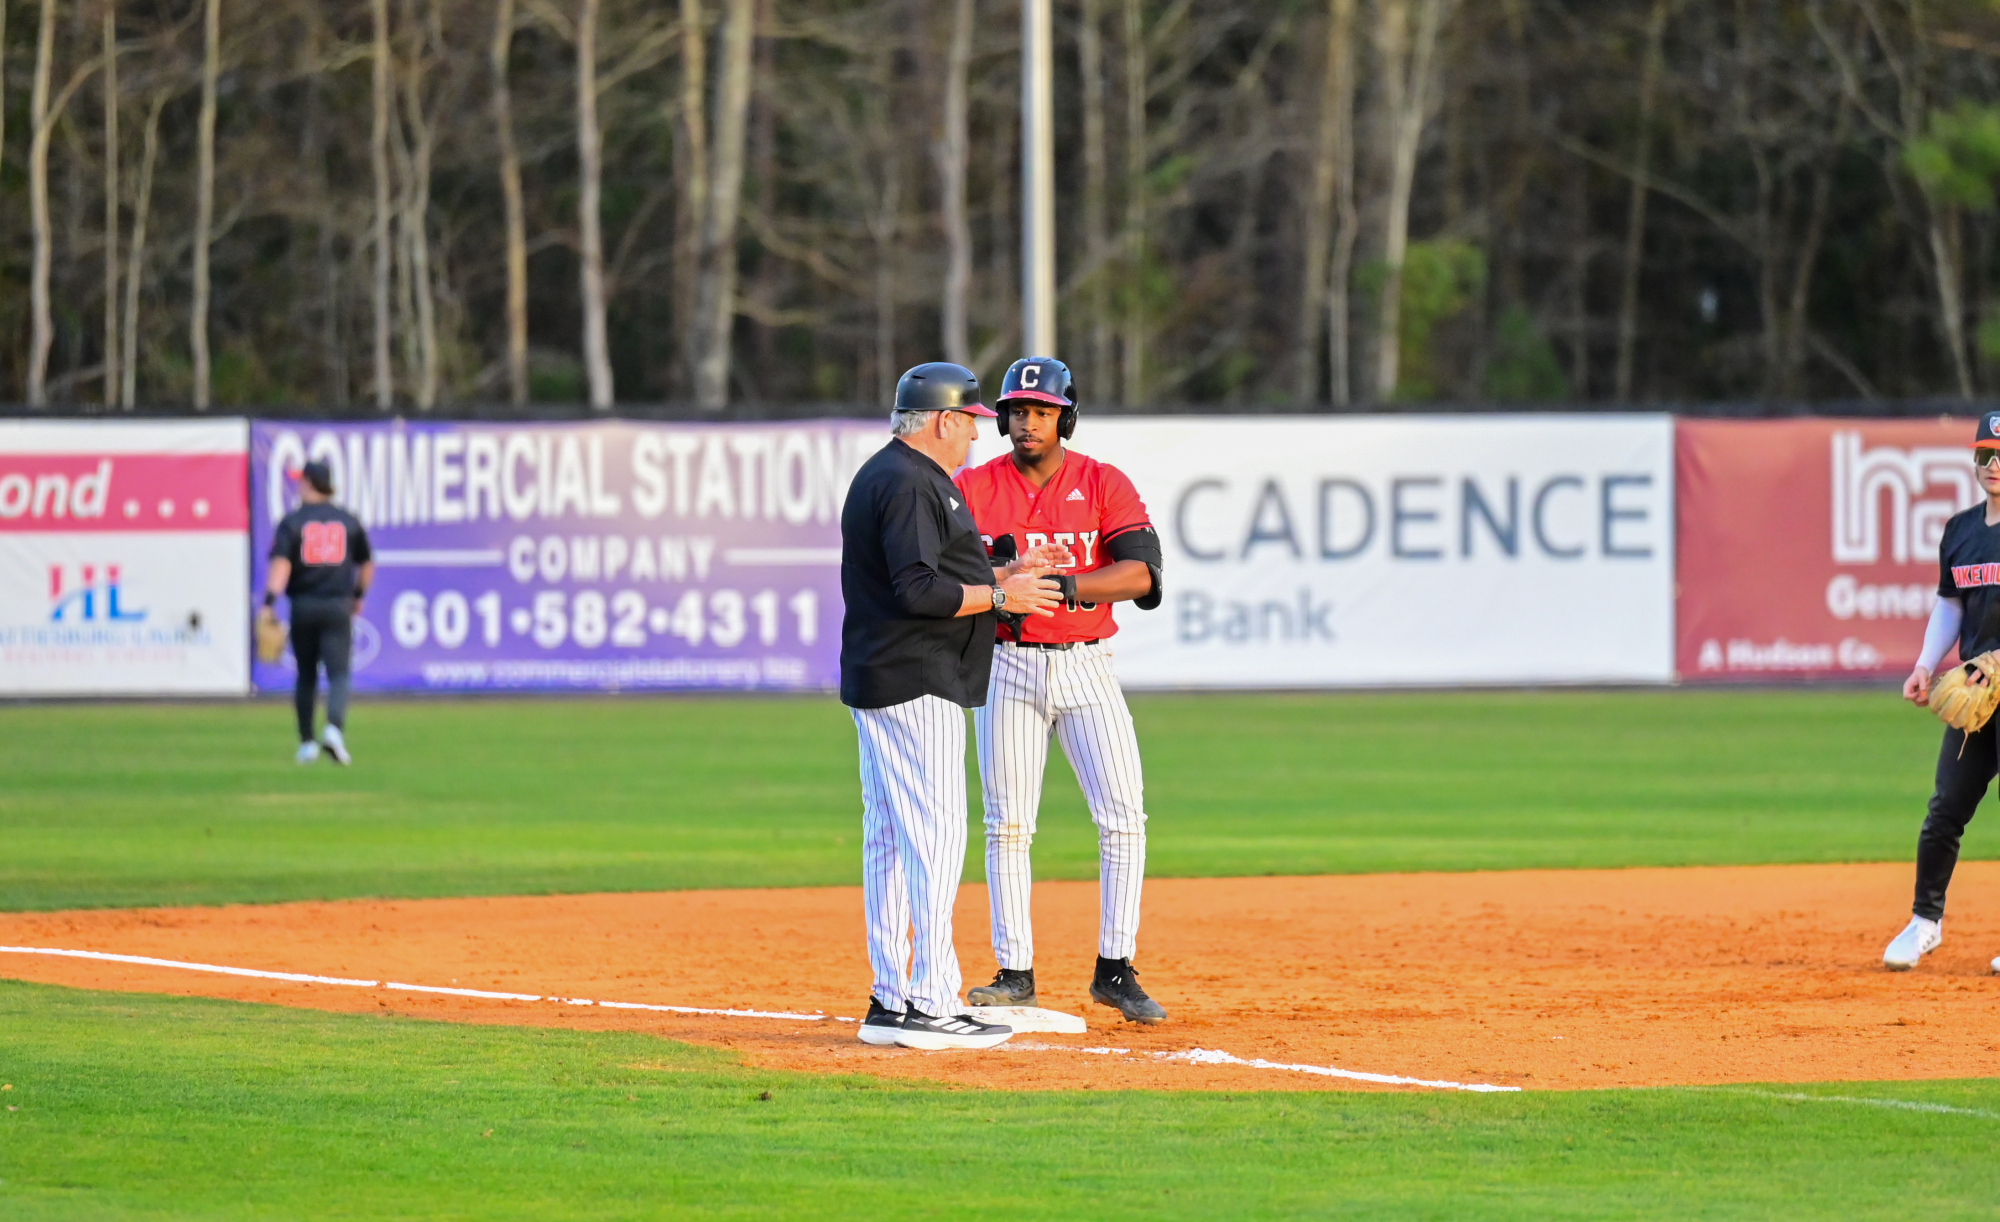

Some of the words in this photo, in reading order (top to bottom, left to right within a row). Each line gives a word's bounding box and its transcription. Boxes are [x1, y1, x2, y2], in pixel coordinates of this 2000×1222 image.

[1020, 365, 1041, 390] C
[266, 430, 621, 529] COMMERCIAL
[630, 430, 888, 527] STATION
[1172, 475, 1654, 562] CADENCE
[508, 535, 715, 583] COMPANY
[1176, 588, 1336, 645] Bank
